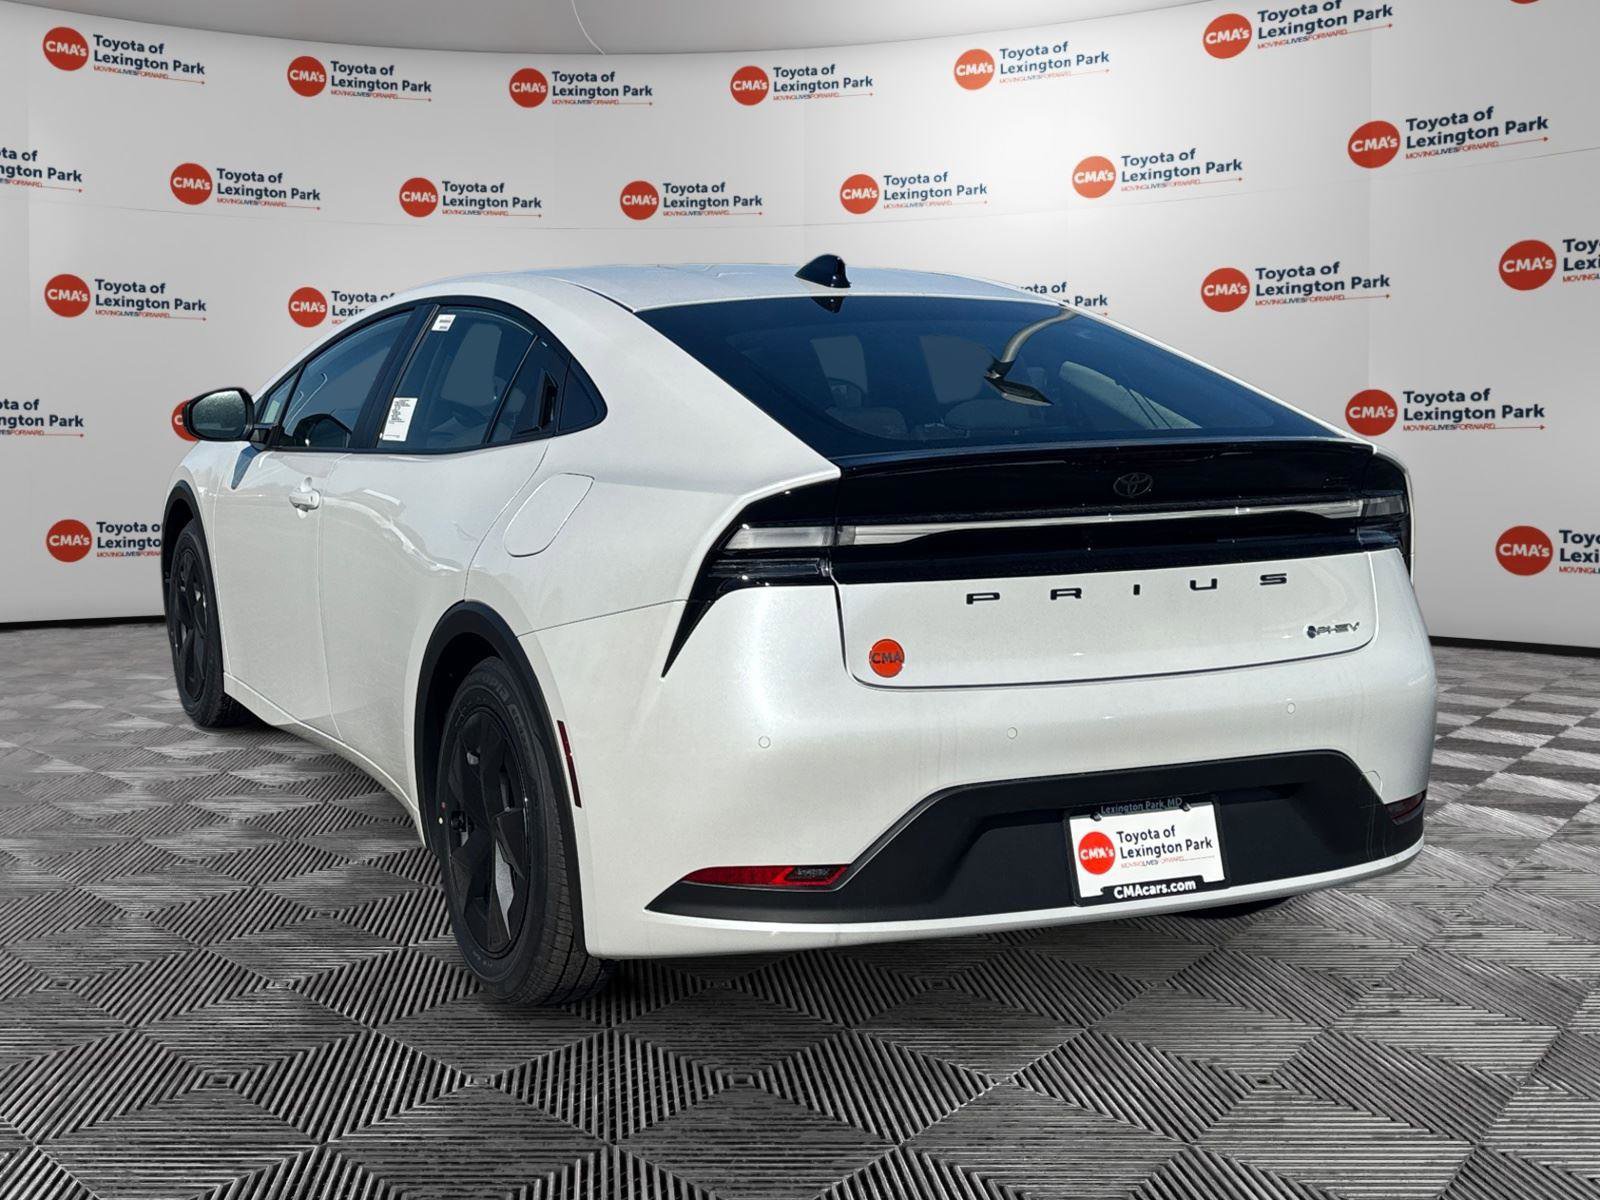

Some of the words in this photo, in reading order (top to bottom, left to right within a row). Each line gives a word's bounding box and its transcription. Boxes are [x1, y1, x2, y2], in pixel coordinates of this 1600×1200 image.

[1257, 5, 1318, 24] Toyota
[1323, 0, 1342, 12] of
[1258, 16, 1348, 40] Lexington
[1354, 4, 1393, 24] Park
[93, 34, 145, 54] Toyota
[149, 44, 165, 54] of
[1206, 28, 1250, 45] CMA's
[46, 41, 87, 57] CMA's
[1000, 46, 1049, 61] Toyota
[1053, 41, 1068, 54] of
[94, 50, 169, 70] Lexington
[173, 60, 205, 75] Park
[331, 61, 377, 76] Toyota
[380, 66, 395, 76] of
[956, 62, 993, 77] CMA's
[1000, 60, 1072, 76] Lexington
[1076, 52, 1110, 66] Park
[290, 70, 325, 83] CMA's
[552, 71, 598, 84] Toyota
[601, 71, 616, 82] of
[774, 66, 818, 80] Toyota
[821, 64, 836, 76] of
[331, 76, 398, 92] Lexington
[402, 80, 432, 93] Park
[512, 82, 546, 94] CMA's
[552, 86, 619, 100] Lexington
[623, 85, 653, 97] Park
[734, 79, 767, 92] CMA's
[774, 80, 840, 94] Lexington
[844, 76, 873, 89] Park
[1405, 113, 1469, 133] Toyota
[1473, 106, 1495, 122] of
[1406, 127, 1499, 150] Lexington
[1505, 115, 1549, 136] Park
[1351, 134, 1397, 152] CMA's
[21, 150, 38, 162] of
[1121, 153, 1175, 169] Toyota
[1179, 148, 1196, 162] of
[48, 167, 82, 183] Park
[217, 168, 265, 184] Toyota
[268, 173, 283, 184] of
[1077, 168, 1113, 184] CMA's
[1122, 167, 1201, 184] Lexington
[1206, 158, 1243, 174] Park
[173, 176, 210, 191] CMA's
[442, 181, 488, 195] Toyota
[491, 183, 505, 194] of
[884, 174, 930, 189] Toyota
[934, 171, 948, 183] of
[217, 183, 287, 200] Lexington
[291, 188, 321, 201] Park
[402, 190, 436, 203] CMA's
[663, 183, 709, 197] Toyota
[712, 181, 726, 193] of
[843, 186, 877, 201] CMA's
[884, 187, 953, 203] Lexington
[957, 183, 988, 196] Park
[442, 195, 509, 210] Lexington
[513, 196, 542, 209] Park
[623, 193, 656, 206] CMA's
[663, 197, 730, 211] Lexington
[734, 194, 763, 207] Park
[1255, 265, 1316, 282] Toyota
[1320, 261, 1340, 276] of
[1503, 257, 1554, 273] CMA's
[95, 279, 147, 295] Toyota
[150, 283, 166, 295] of
[1051, 281, 1067, 294] of
[1204, 279, 1248, 296] CMA's
[1255, 280, 1345, 297] Lexington
[1351, 274, 1390, 290] Park
[48, 288, 89, 302] CMA's
[96, 294, 170, 312] Lexington
[175, 297, 207, 312] Park
[331, 290, 378, 306] Toyota
[1075, 294, 1108, 307] Park
[290, 300, 326, 313] CMA's
[23, 398, 40, 411] of
[1402, 390, 1466, 407] Toyota
[1471, 387, 1491, 402] of
[1348, 404, 1395, 420] CMA's
[1403, 407, 1496, 424] Lexington
[1502, 403, 1545, 419] Park
[49, 415, 84, 428] Park
[96, 521, 148, 537] Toyota
[152, 523, 161, 533] o
[49, 534, 90, 547] CMA's
[1500, 543, 1551, 559] CMA's
[966, 572, 1288, 605] PRIUS
[1101, 803, 1144, 815] Lexington
[1167, 797, 1183, 807] MD
[1116, 828, 1160, 845] Toyota
[1163, 825, 1176, 838] of
[1080, 847, 1115, 860] CMA's
[1120, 841, 1183, 860] Lexington
[1185, 837, 1213, 855] Park
[1114, 879, 1196, 899] CMAcars.com
